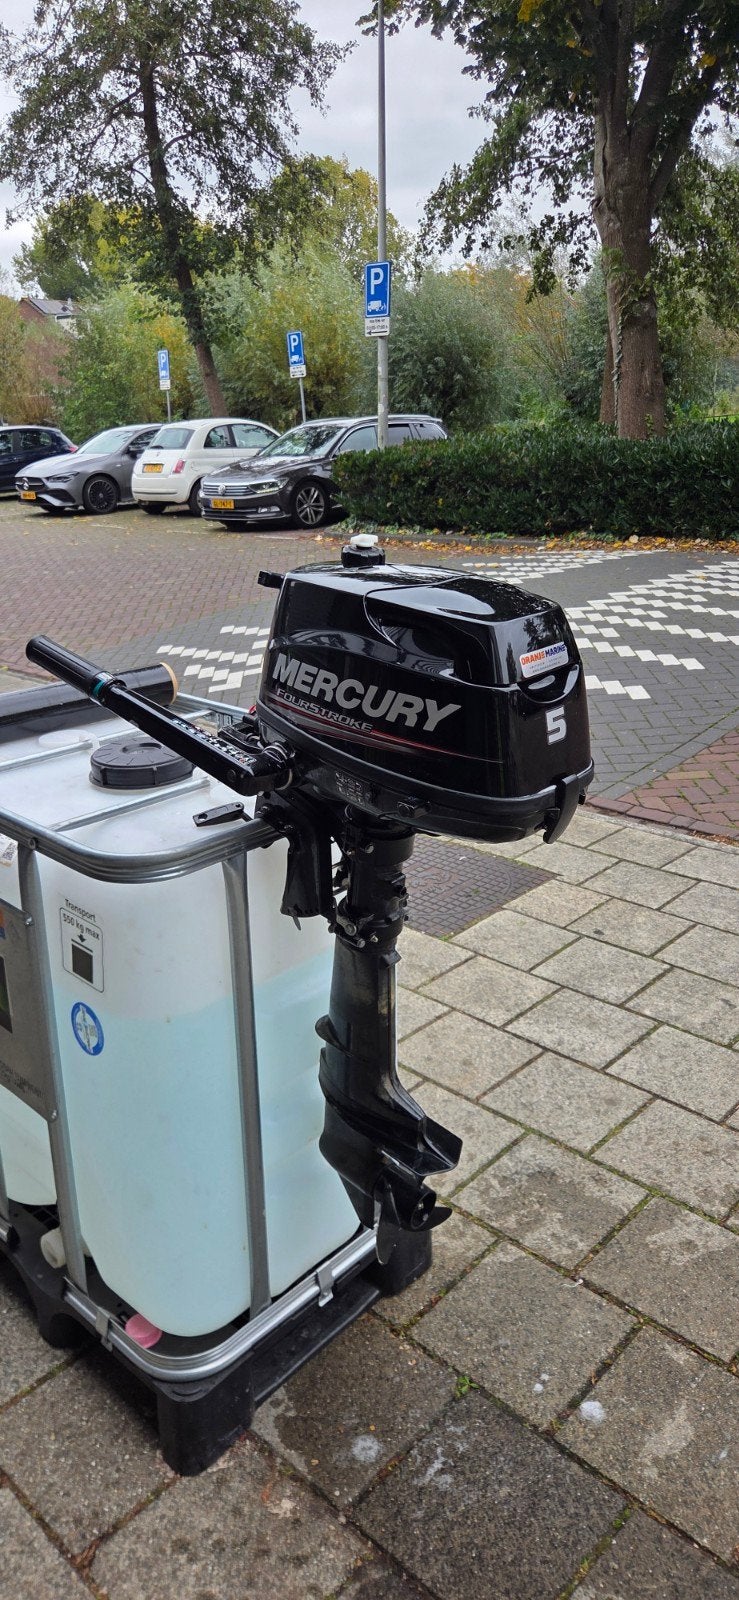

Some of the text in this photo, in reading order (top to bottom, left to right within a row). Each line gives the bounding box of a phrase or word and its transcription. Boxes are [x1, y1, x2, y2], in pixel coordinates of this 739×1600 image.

[370, 267, 384, 295] P
[290, 334, 299, 352] P
[160, 353, 167, 368] P
[272, 653, 462, 732] MERCURY
[276, 689, 374, 731] FOURSTROKE
[546, 704, 567, 744] 5
[65, 898, 96, 922] Transport
[63, 912, 100, 940] 550 kg max
